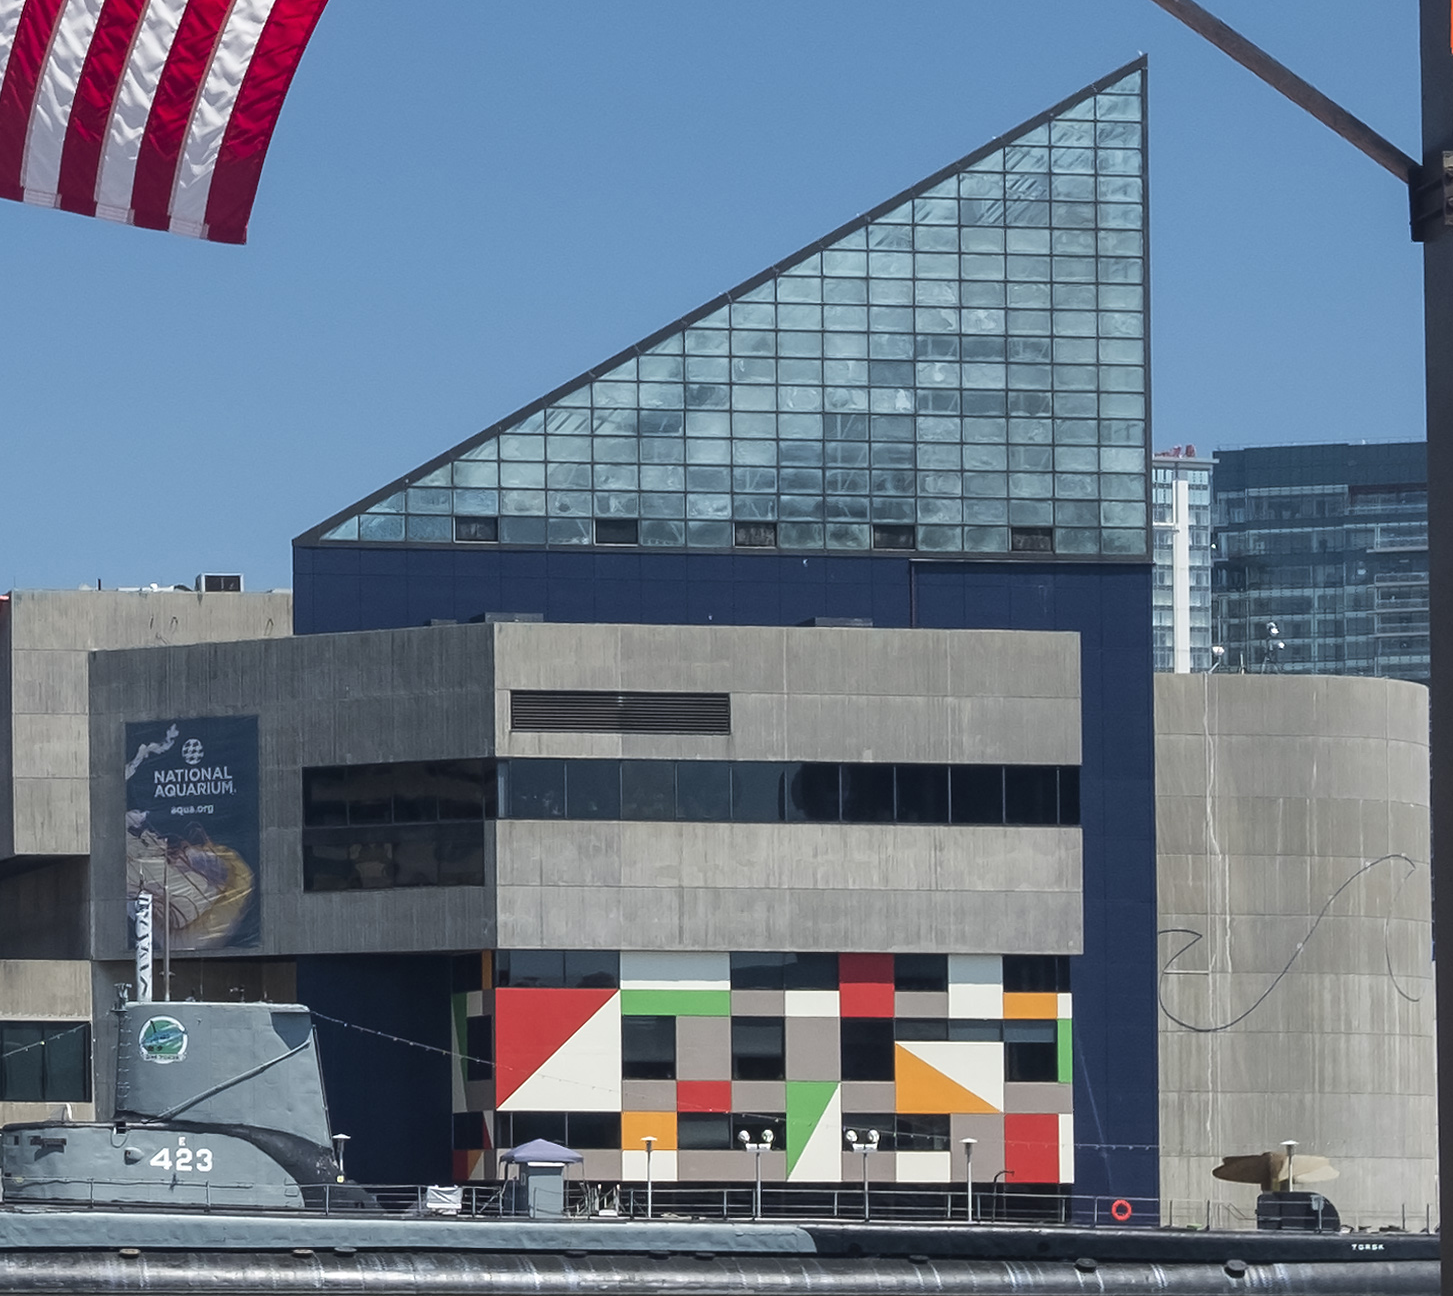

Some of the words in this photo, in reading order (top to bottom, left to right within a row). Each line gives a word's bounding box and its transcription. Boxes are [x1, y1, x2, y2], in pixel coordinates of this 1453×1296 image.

[154, 766, 233, 783] NATIONAL
[170, 804, 214, 815] aqua.org
[178, 1136, 186, 1146] E
[149, 1147, 213, 1172] 423
